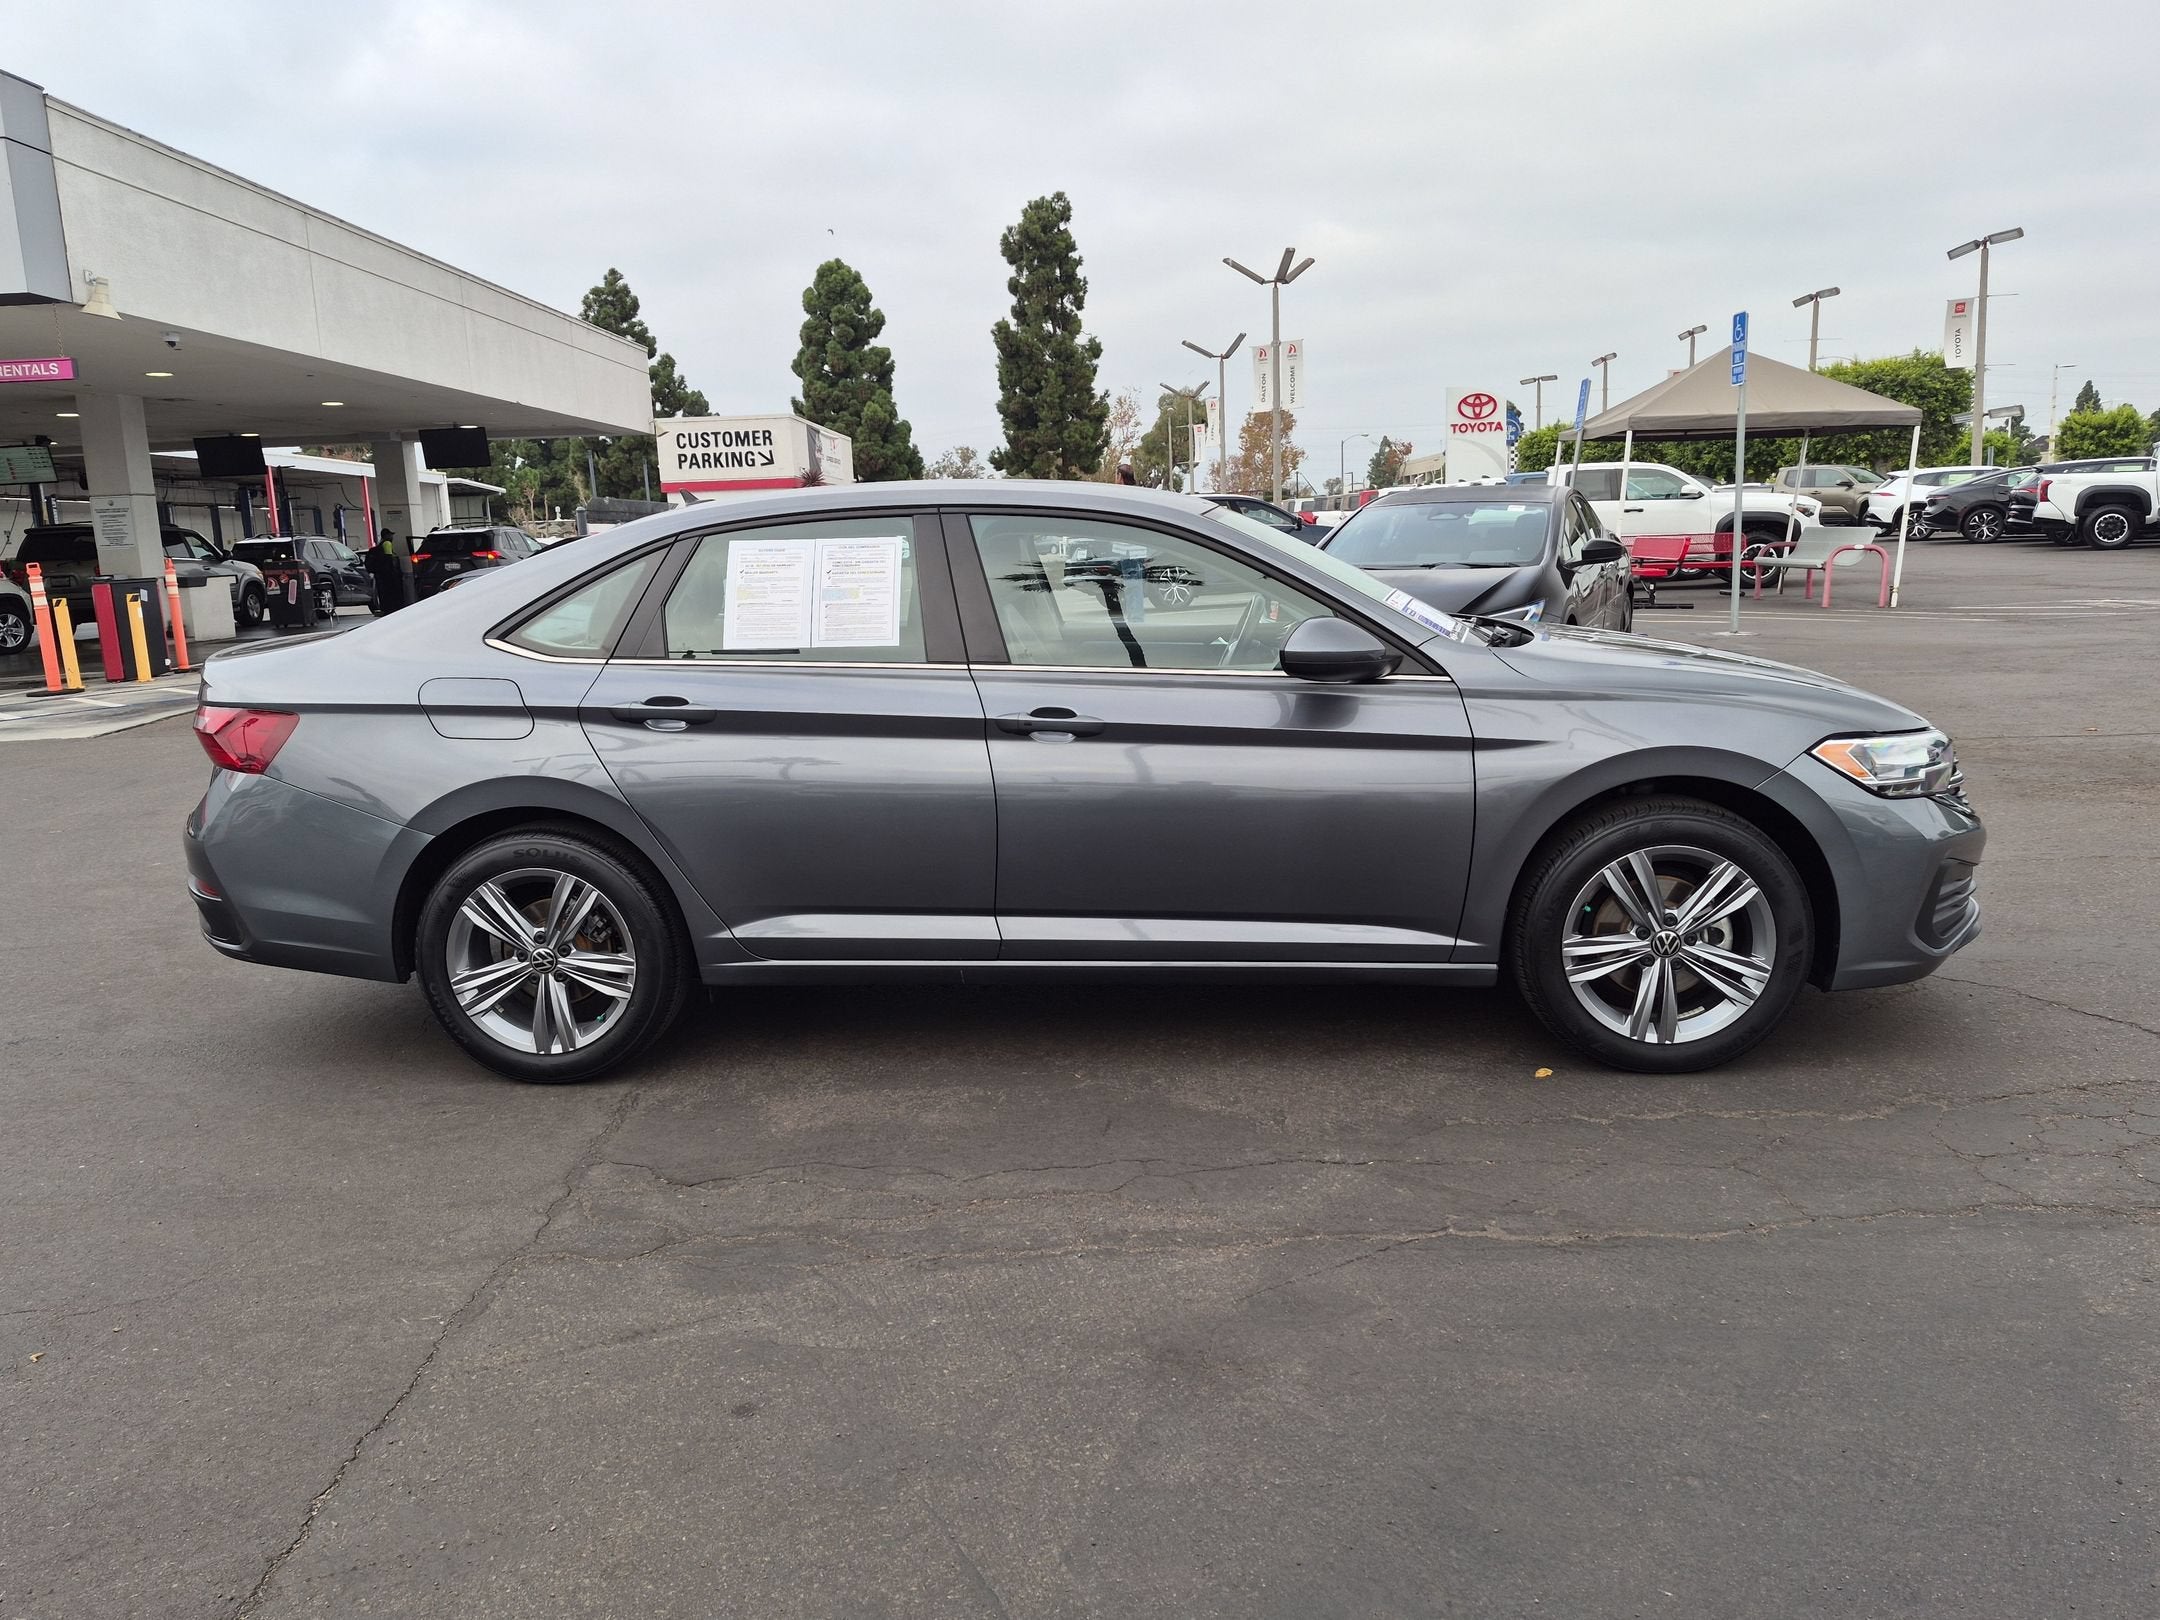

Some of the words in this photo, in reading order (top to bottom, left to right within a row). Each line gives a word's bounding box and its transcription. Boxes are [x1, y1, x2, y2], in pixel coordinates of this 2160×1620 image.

[1954, 327, 1962, 359] TOYOTA
[1450, 421, 1504, 434] TOYOTA
[676, 429, 773, 449] CUSTOMER
[677, 450, 756, 470] PARKING
